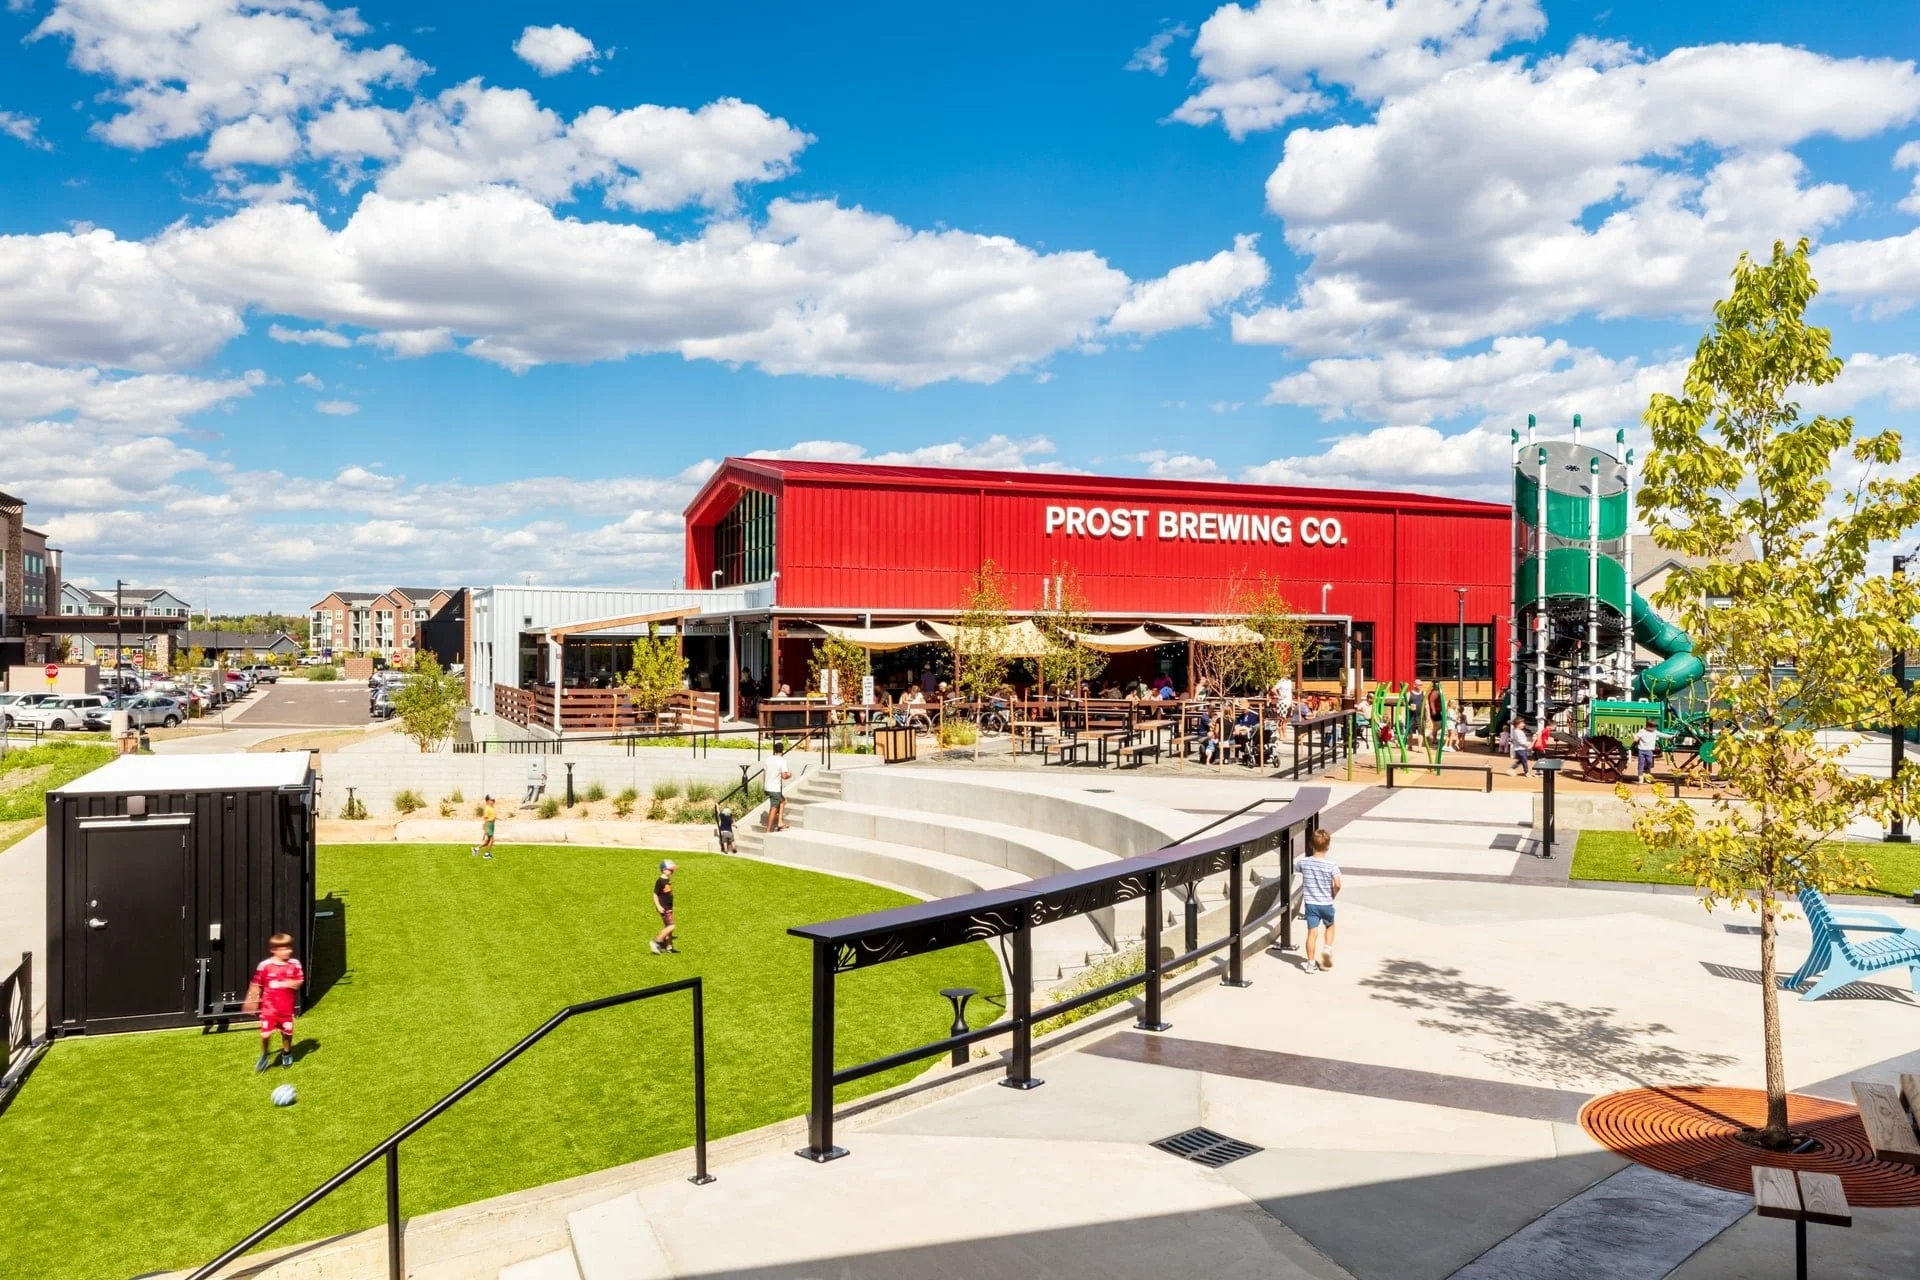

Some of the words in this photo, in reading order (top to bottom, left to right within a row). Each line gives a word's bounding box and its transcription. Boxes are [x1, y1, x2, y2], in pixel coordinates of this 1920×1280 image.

[1045, 506, 1149, 538] PROST
[1158, 510, 1292, 543] BREWING
[1300, 517, 1348, 545] CO.
